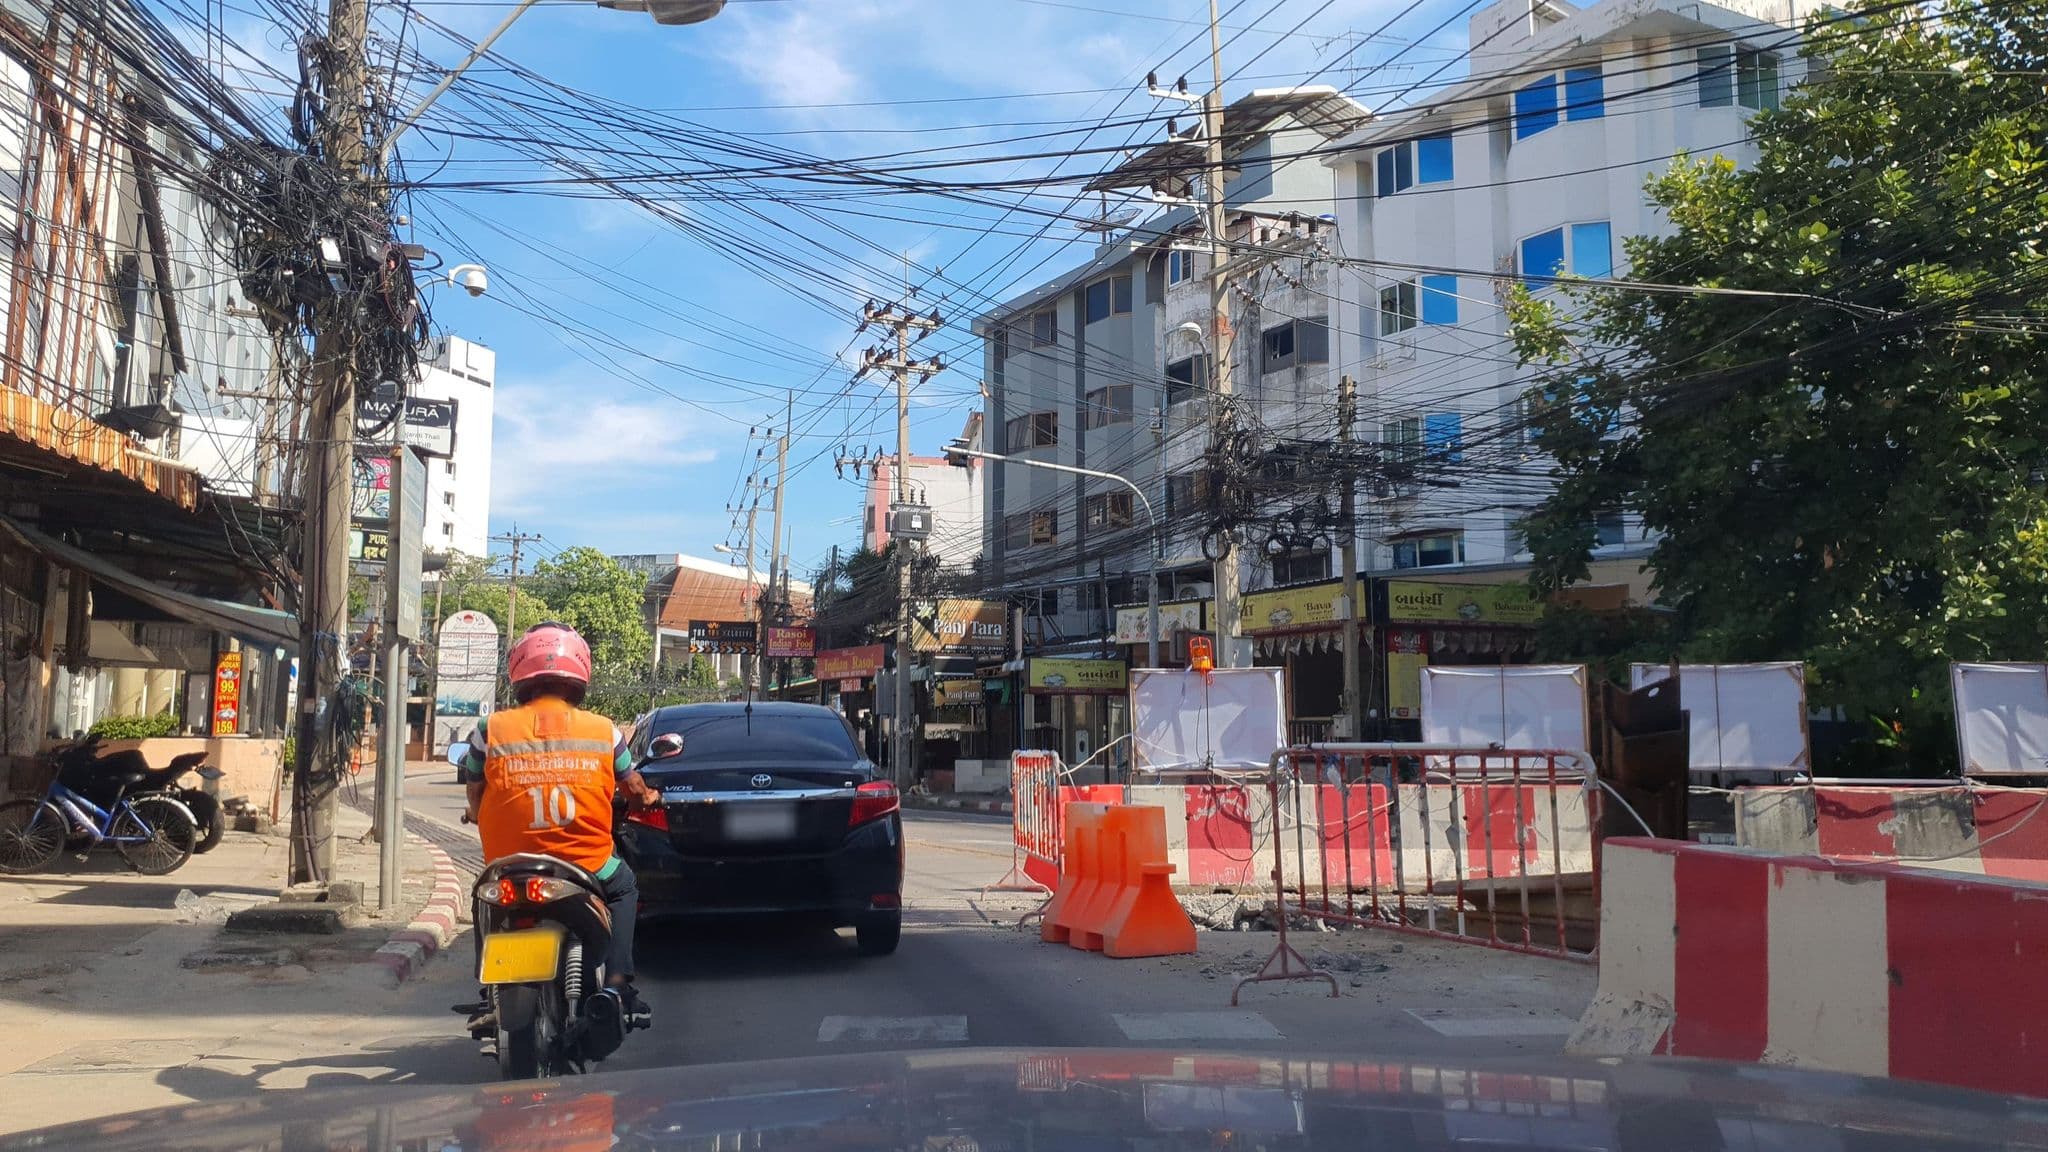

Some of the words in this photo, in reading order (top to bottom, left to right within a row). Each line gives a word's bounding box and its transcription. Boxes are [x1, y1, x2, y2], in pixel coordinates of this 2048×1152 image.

[776, 629, 806, 638] Rasoi
[934, 618, 966, 638] Panj
[970, 621, 1002, 635] Tara
[769, 638, 792, 648] Indian
[796, 638, 813, 648] Food
[824, 658, 848, 672] Indian
[852, 654, 874, 669] Rasoi
[945, 690, 962, 700] Panj
[528, 784, 576, 829] 10
